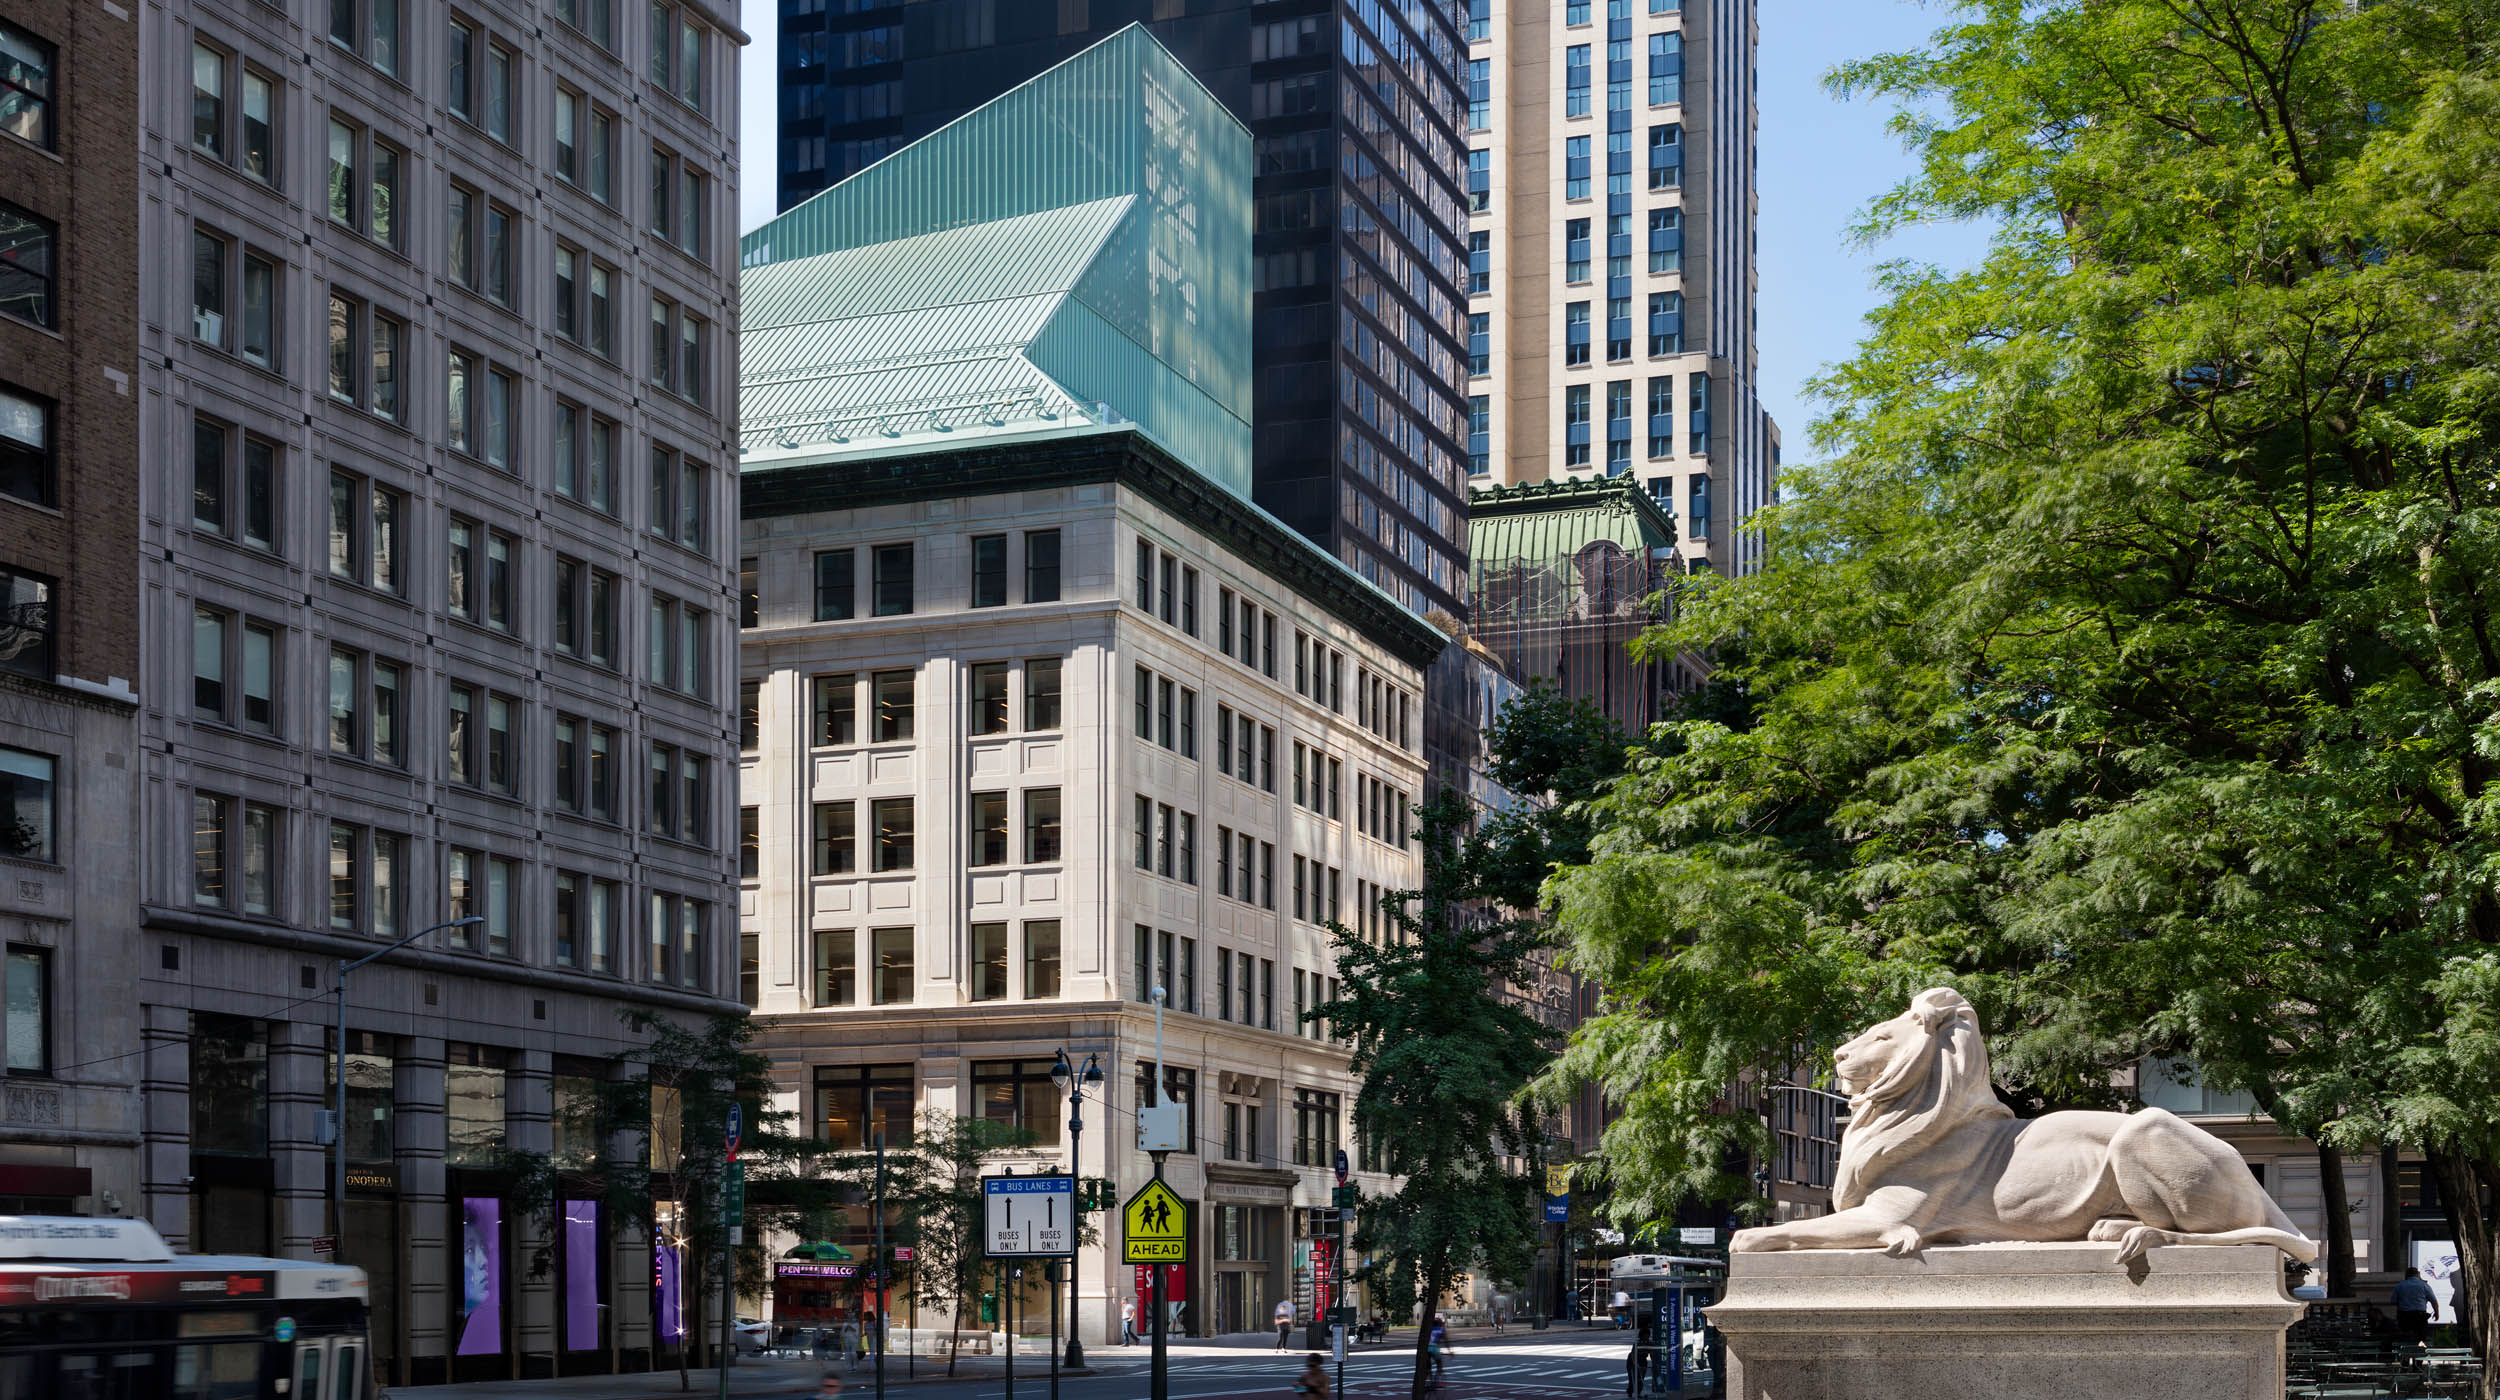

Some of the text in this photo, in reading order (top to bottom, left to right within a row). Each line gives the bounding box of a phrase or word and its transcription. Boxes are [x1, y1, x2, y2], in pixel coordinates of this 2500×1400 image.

[346, 1175, 393, 1187] ONODERA
[1007, 1181, 1052, 1191] BUS LANES
[998, 1231, 1019, 1240] BUSES
[1040, 1230, 1061, 1239] BUSES
[1000, 1242, 1018, 1251] ONLY
[1042, 1241, 1060, 1250] ONLY
[1131, 1244, 1181, 1255] AHEAD
[821, 1266, 856, 1275] WELCO
